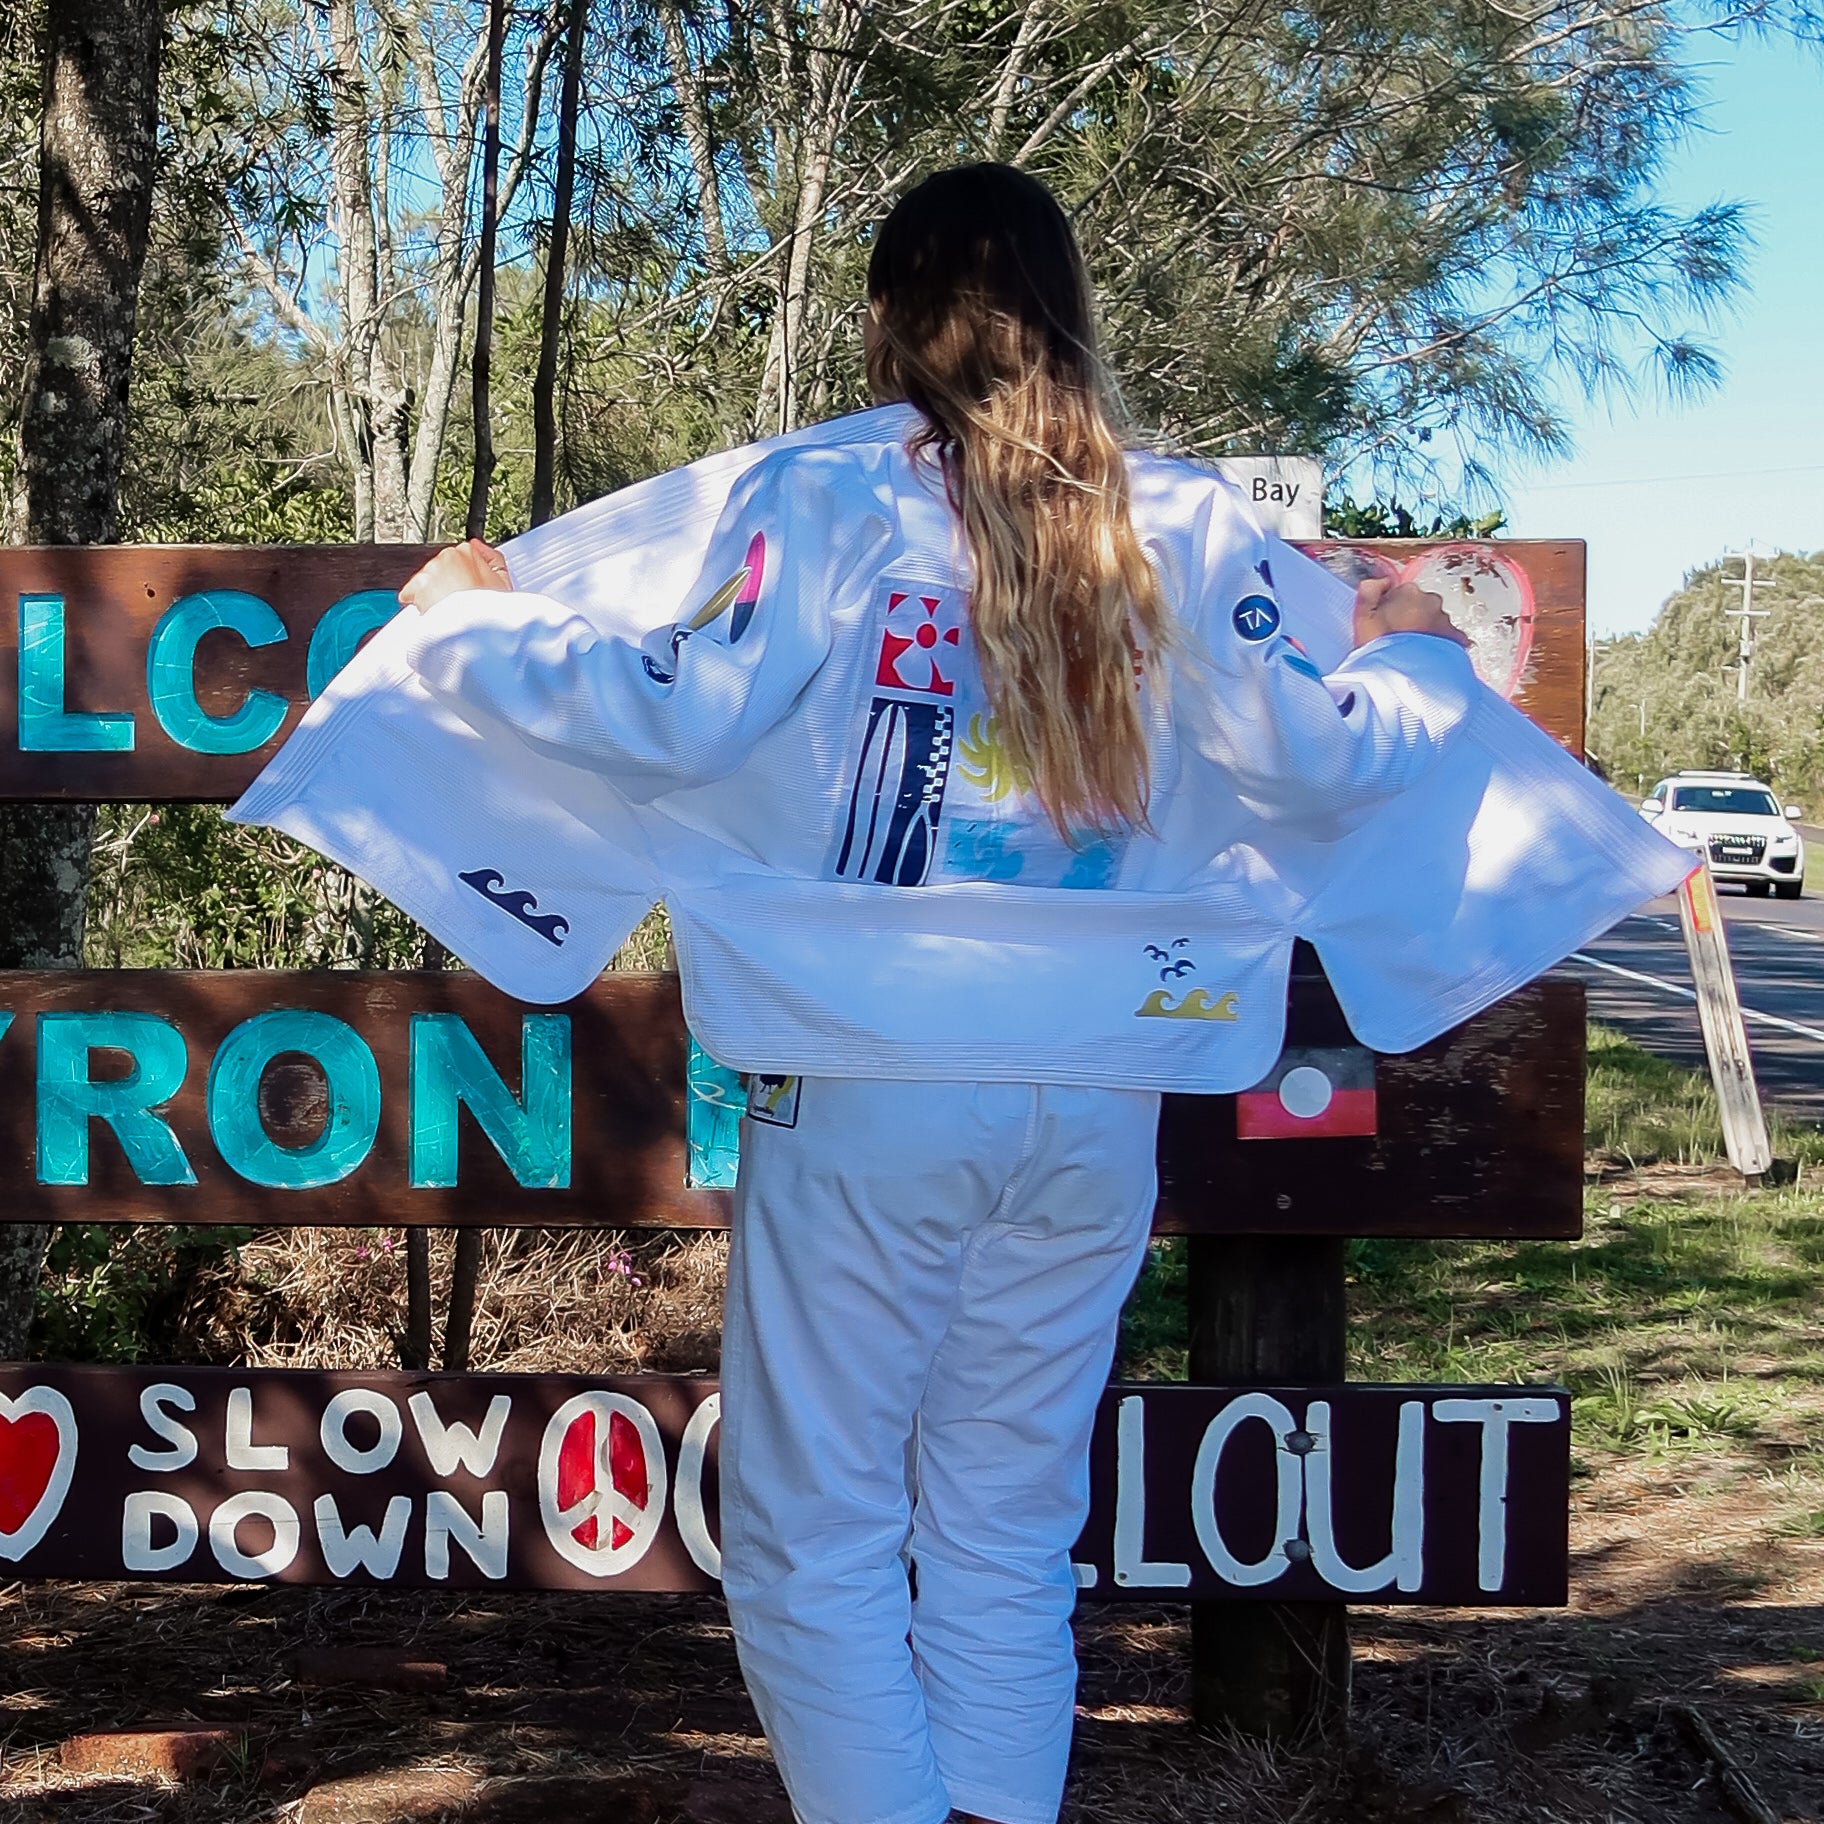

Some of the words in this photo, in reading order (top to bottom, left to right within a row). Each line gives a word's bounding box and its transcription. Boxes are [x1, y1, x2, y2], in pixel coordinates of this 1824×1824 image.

[1252, 477, 1300, 508] Bay
[127, 1382, 512, 1478] SLOW
[121, 1490, 510, 1580] DOWN
